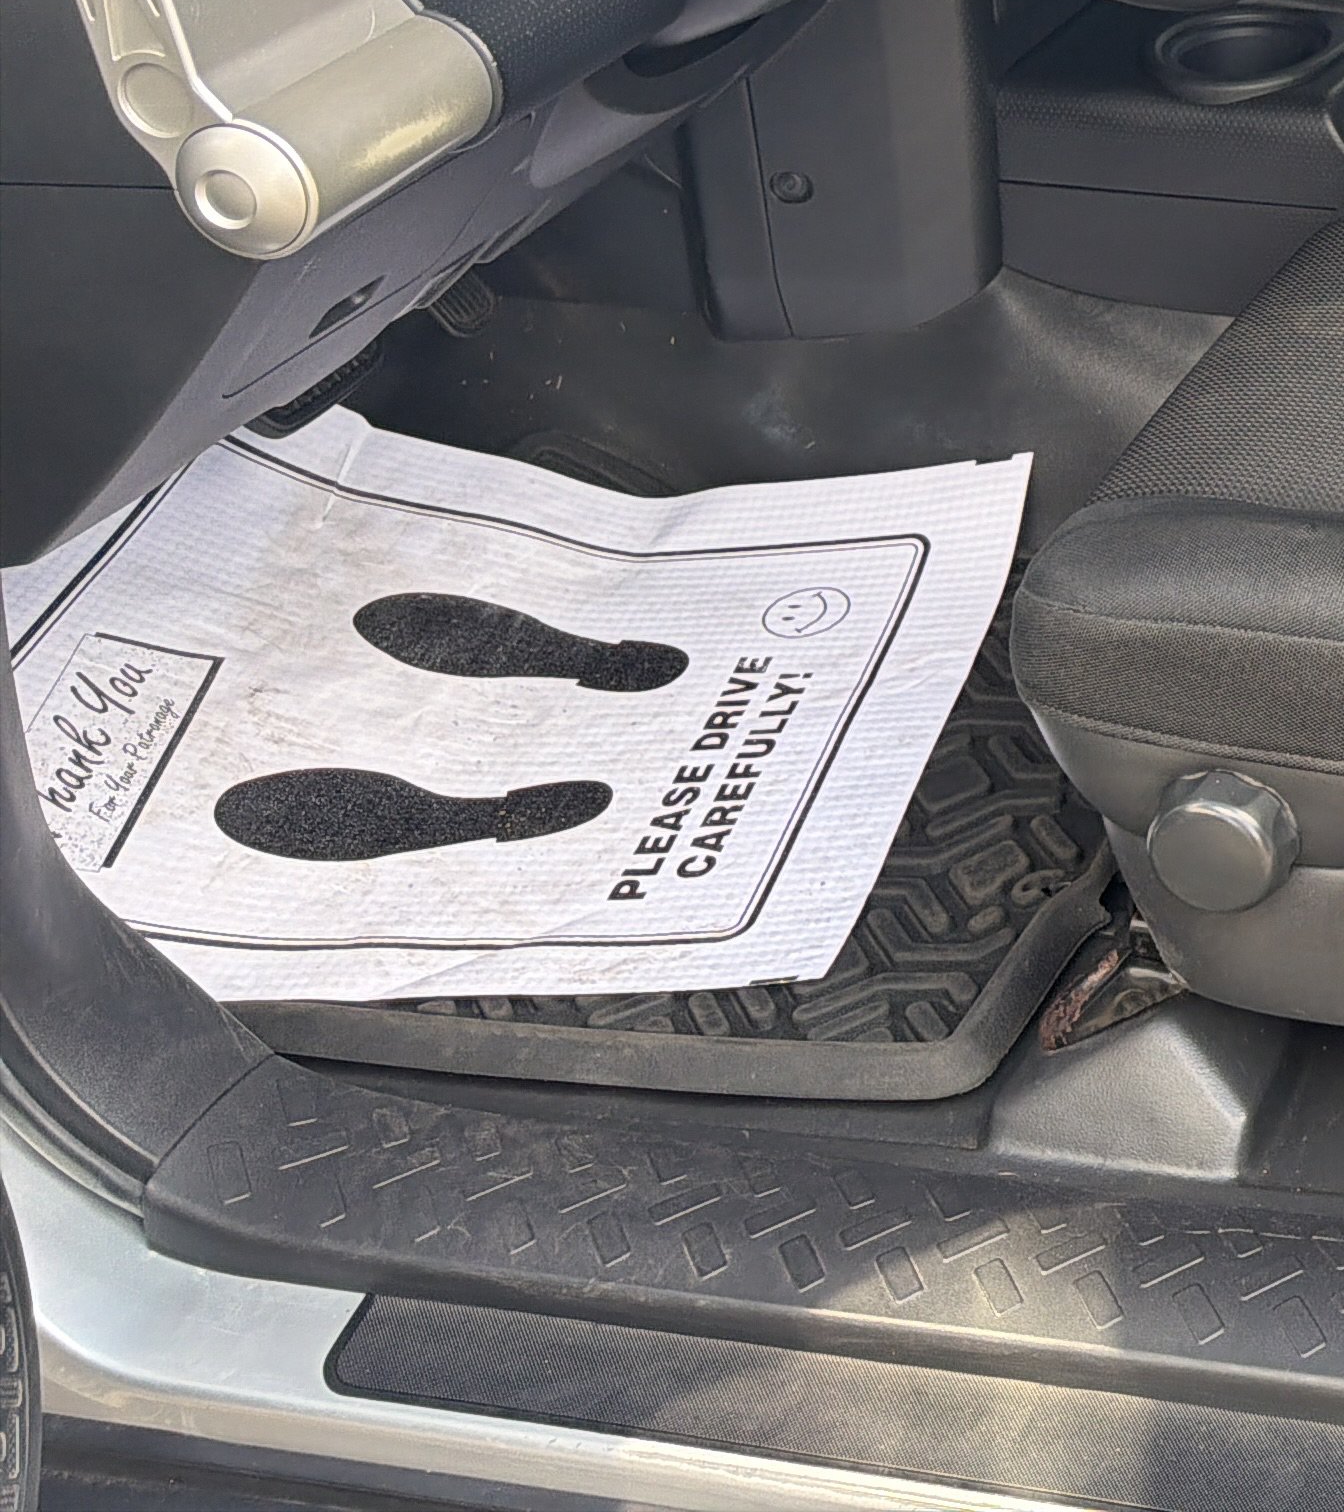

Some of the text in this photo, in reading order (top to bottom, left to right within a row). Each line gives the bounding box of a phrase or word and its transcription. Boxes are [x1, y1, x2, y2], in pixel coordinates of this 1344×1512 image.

[38, 662, 154, 813] hank You
[88, 697, 182, 823] For Your Patronage
[607, 656, 773, 901] PLEASE DRIVE
[676, 672, 813, 879] CAREFULLY!
